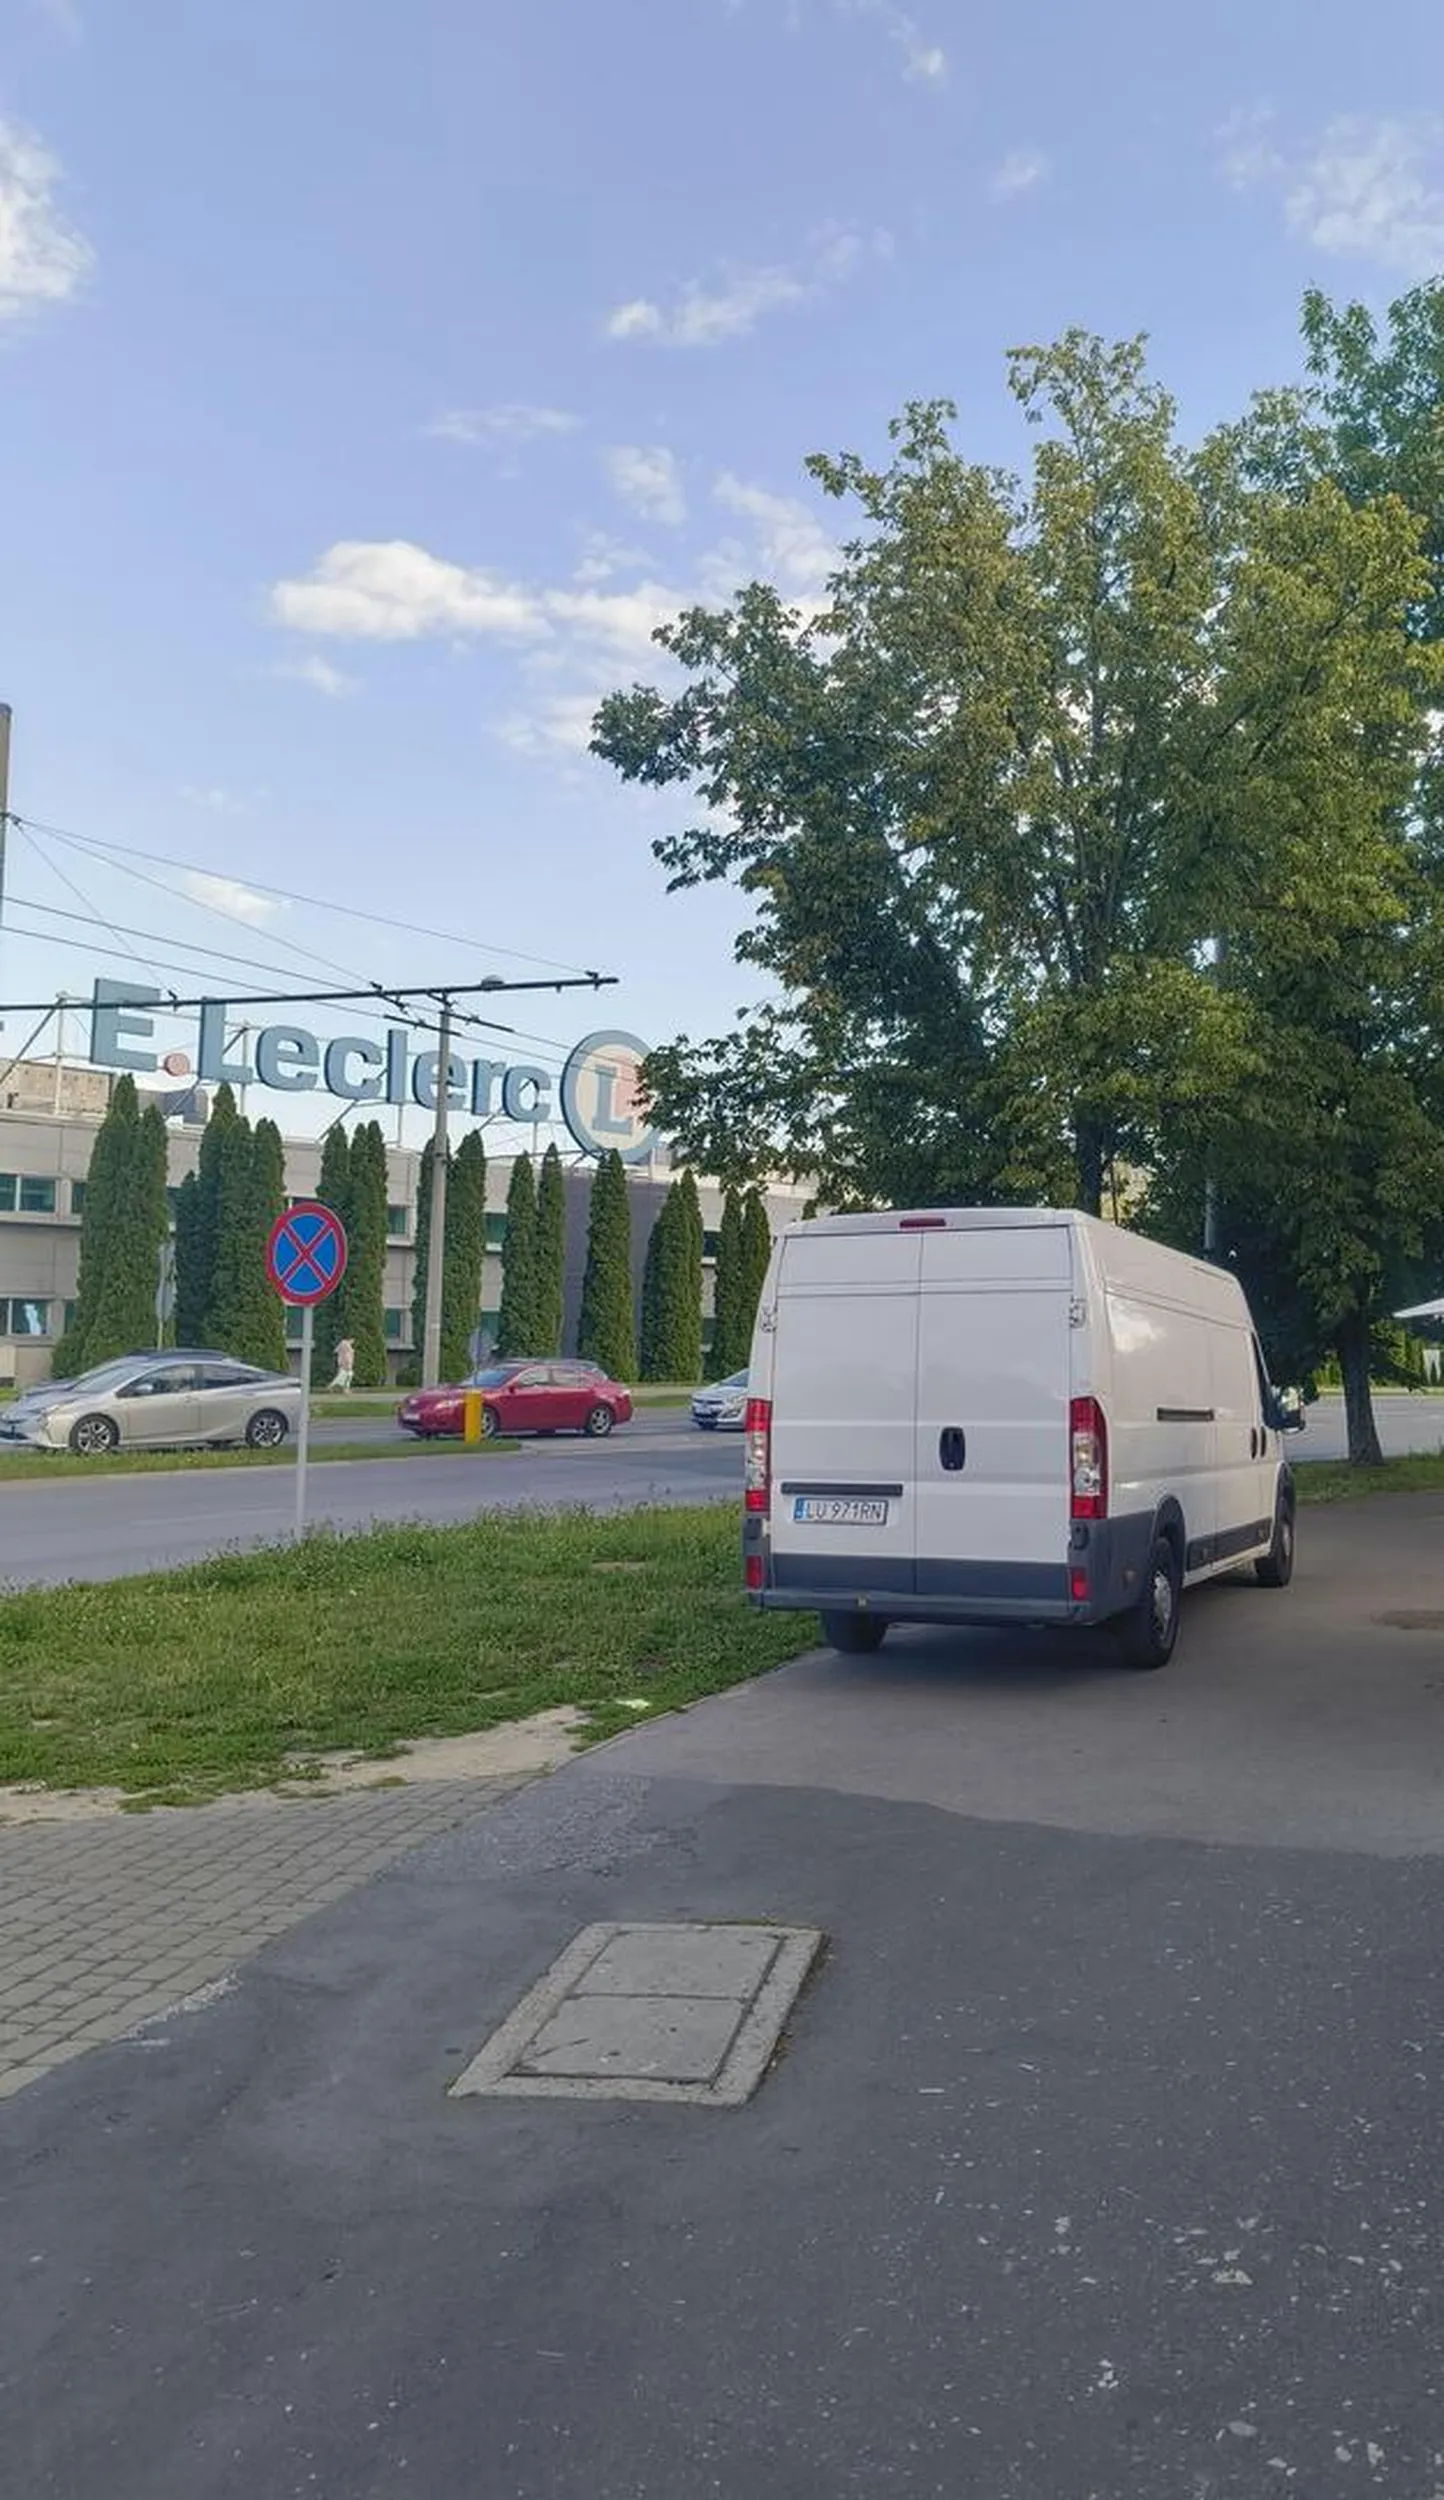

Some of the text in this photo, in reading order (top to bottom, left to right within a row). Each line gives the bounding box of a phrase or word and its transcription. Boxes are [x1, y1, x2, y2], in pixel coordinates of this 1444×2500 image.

[90, 977, 633, 1135] E.Leclerc L
[806, 1502, 882, 1520] LU 971RN
